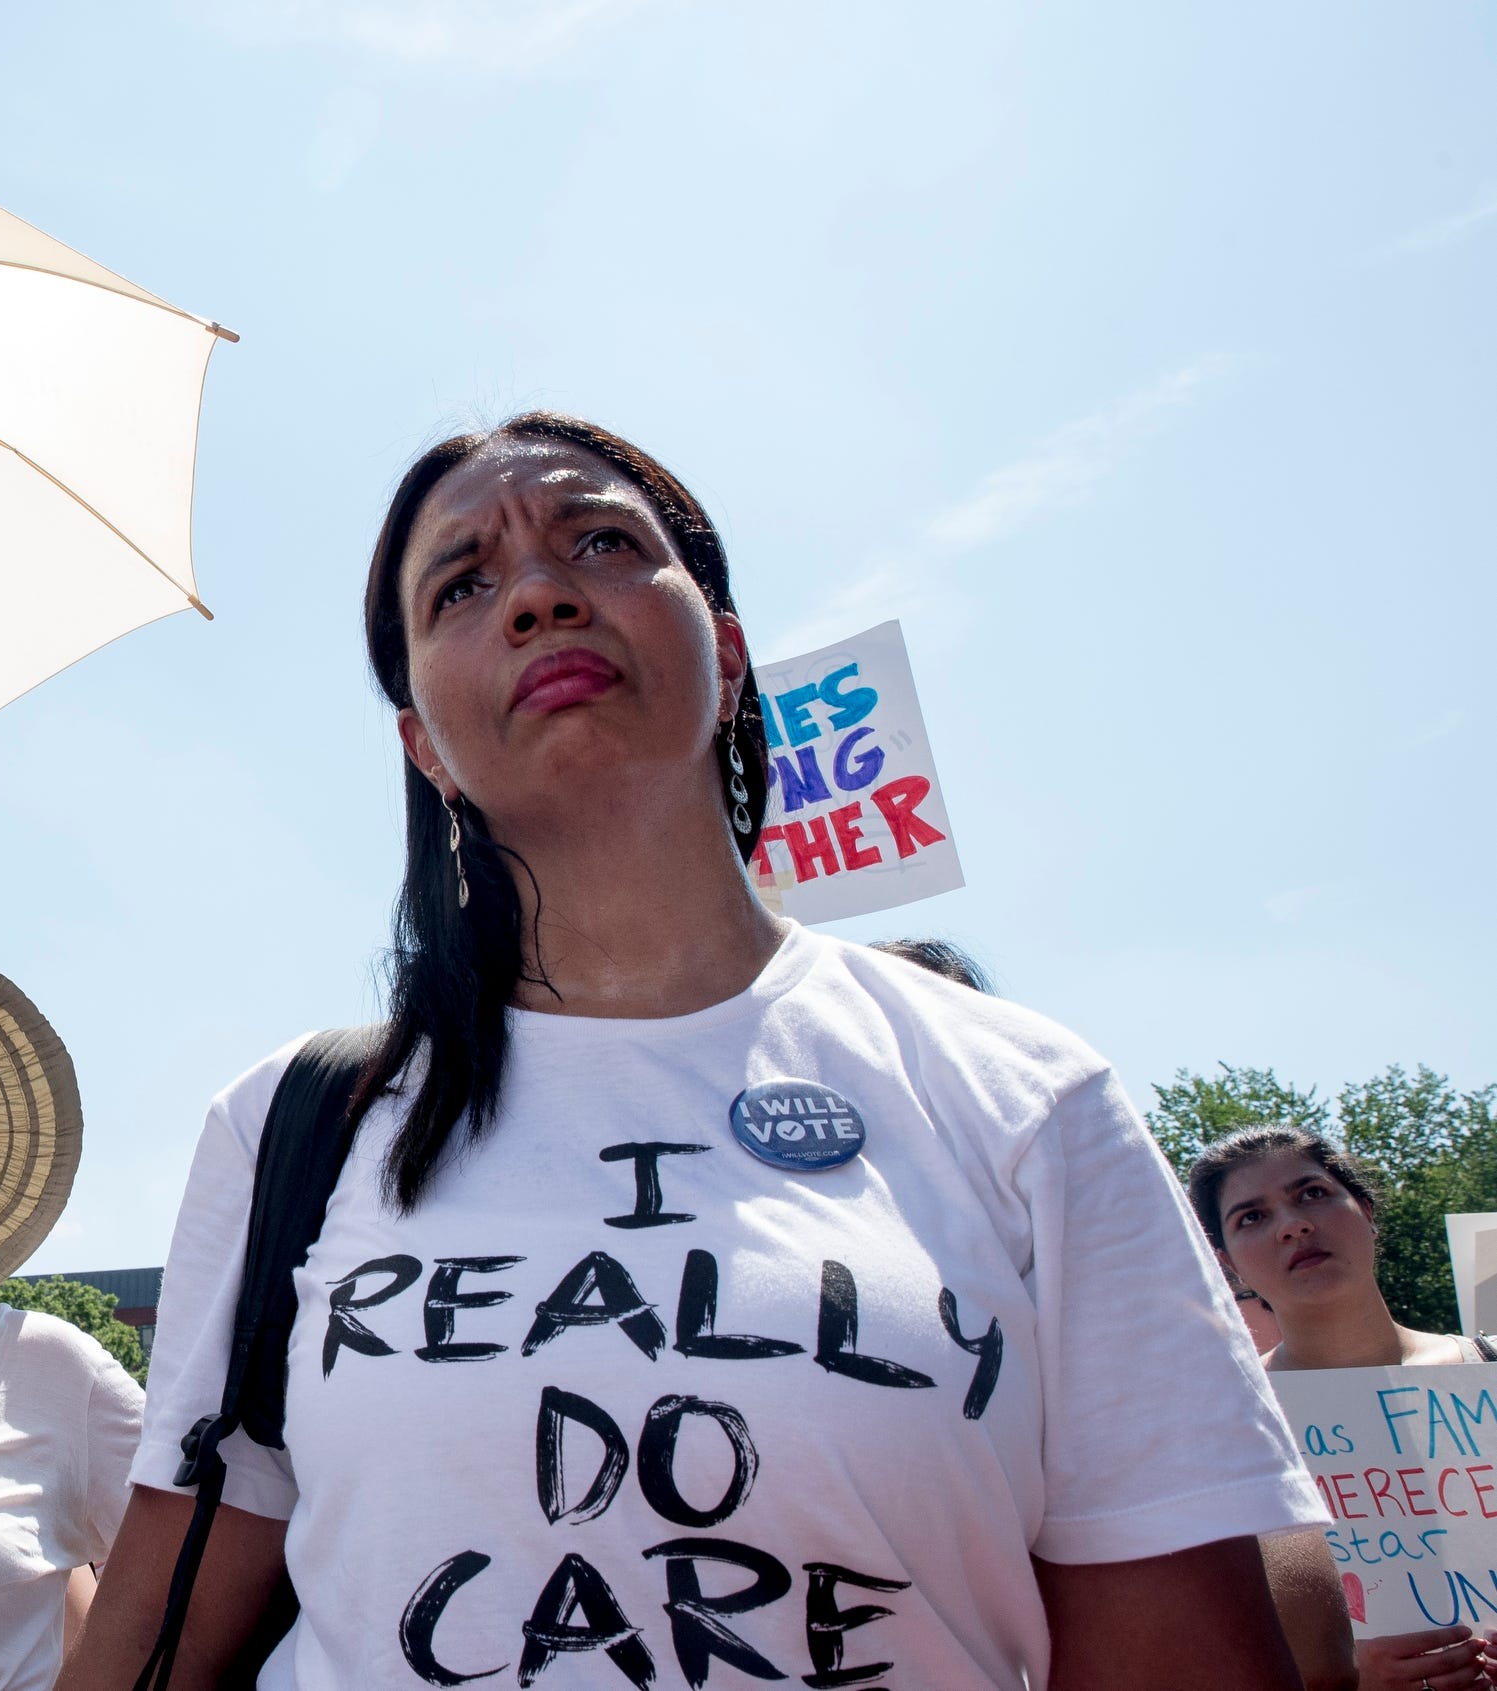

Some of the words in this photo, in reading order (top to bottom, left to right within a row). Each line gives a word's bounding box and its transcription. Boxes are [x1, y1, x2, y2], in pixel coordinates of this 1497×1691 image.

[738, 1101, 752, 1118] I
[758, 1096, 849, 1117] WILL
[744, 1118, 860, 1143] VOTE
[599, 1142, 720, 1230] I
[323, 1248, 1004, 1420] REALLY
[535, 1385, 759, 1529] DO
[399, 1537, 912, 1691] CARE
